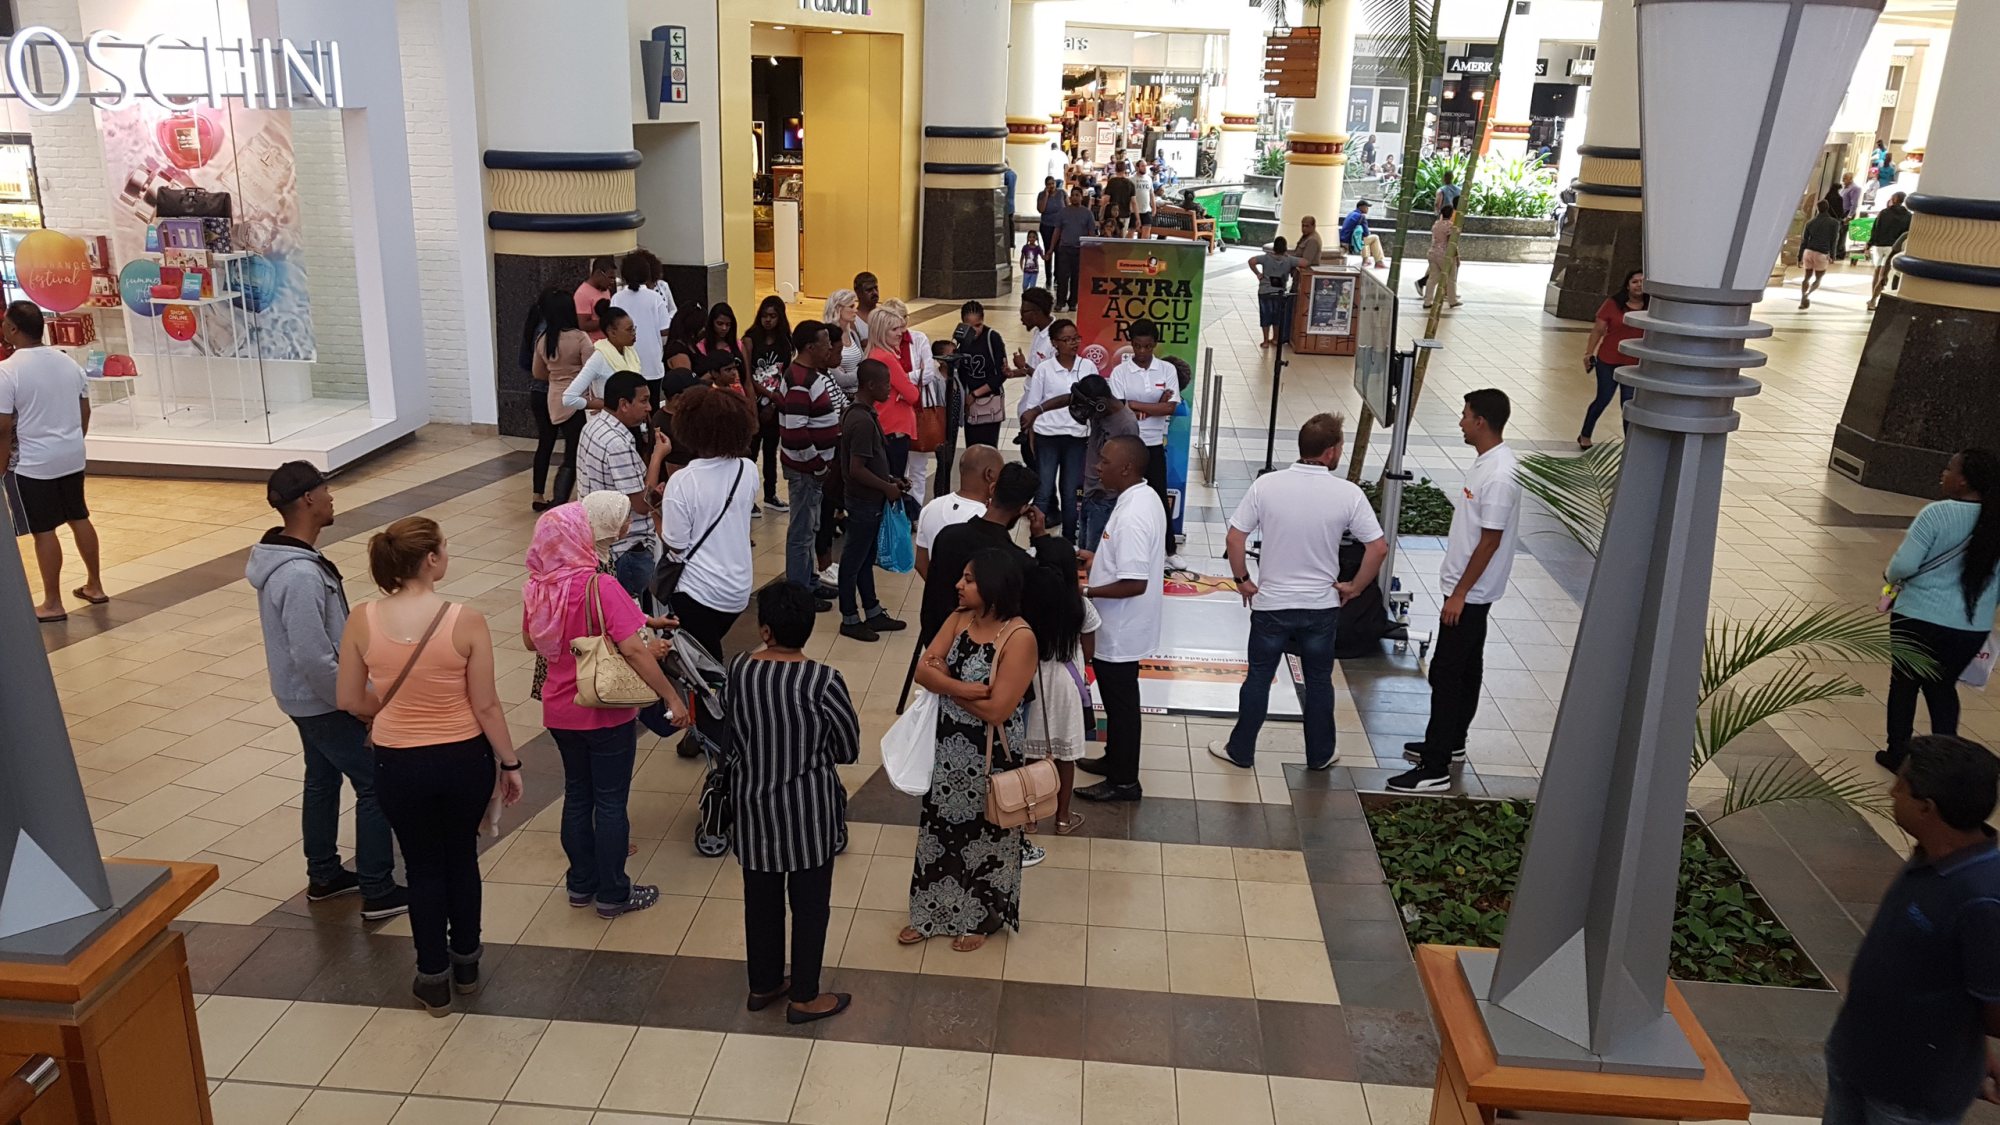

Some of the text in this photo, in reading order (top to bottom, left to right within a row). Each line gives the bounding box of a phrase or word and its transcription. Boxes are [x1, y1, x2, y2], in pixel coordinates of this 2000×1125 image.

[5, 25, 344, 112] OSCHINI
[1091, 277, 1193, 298] EXTRA
[1102, 297, 1193, 321] ACCU
[1113, 320, 1190, 344] RTE
